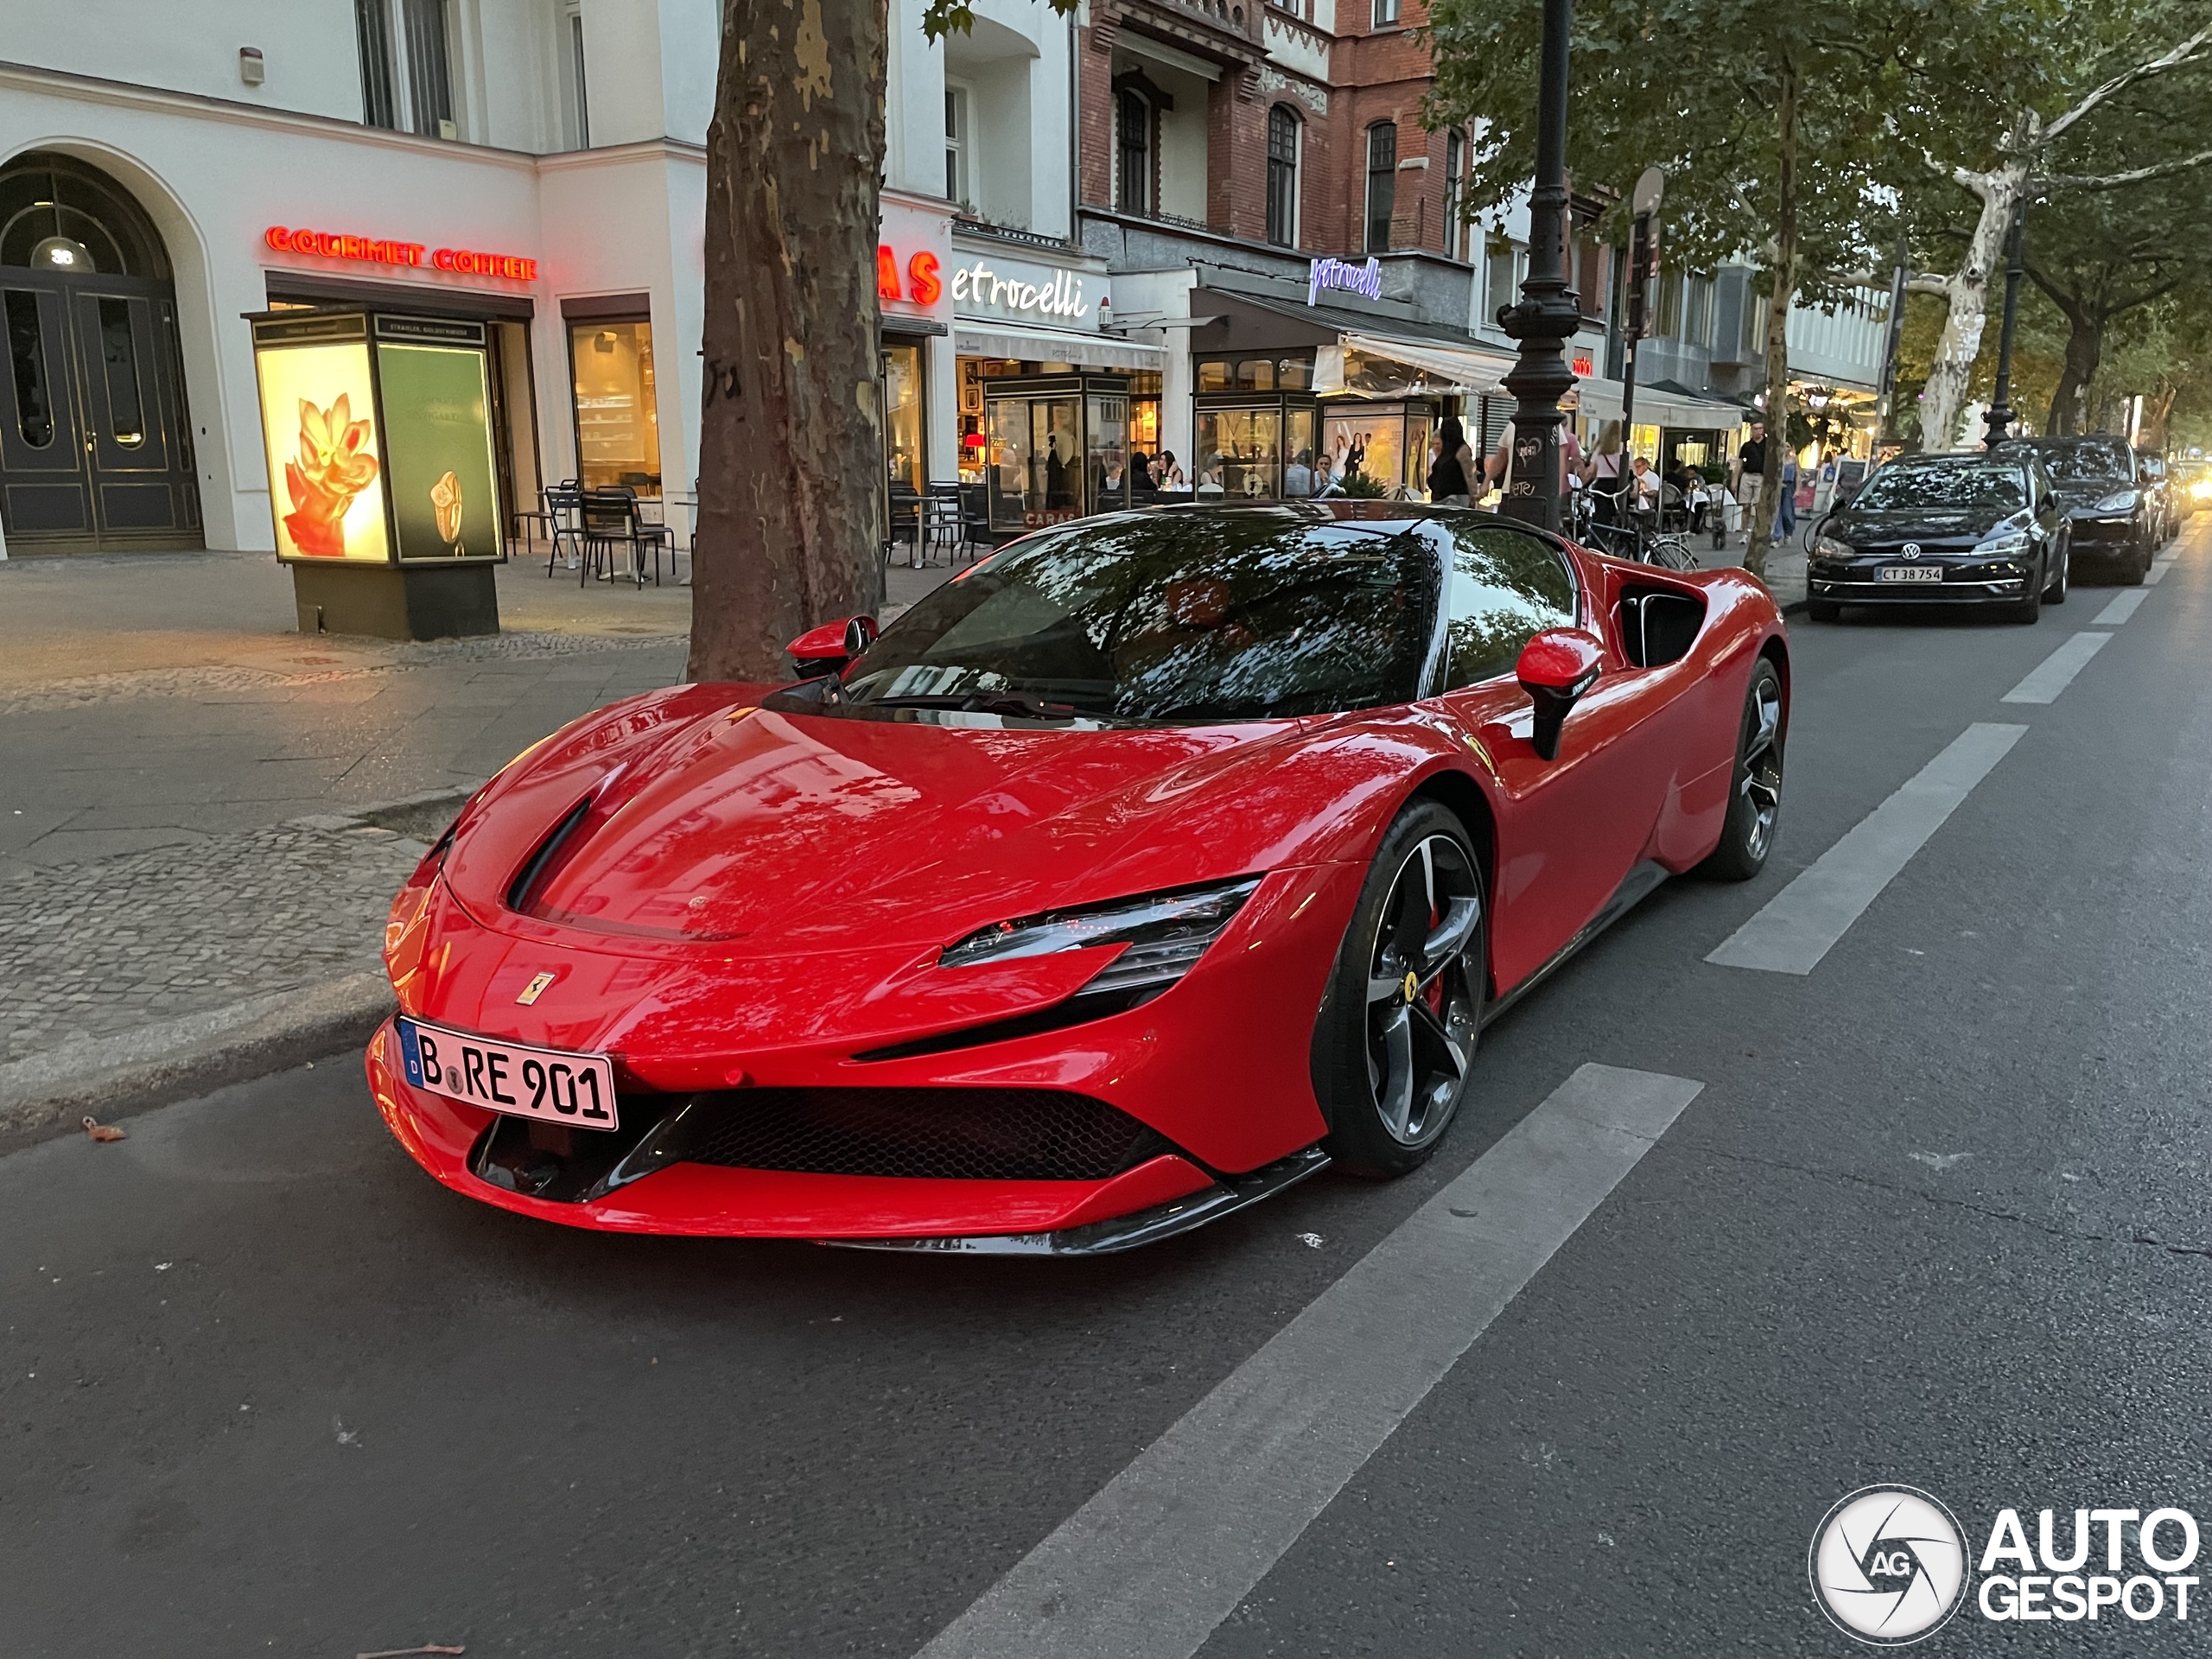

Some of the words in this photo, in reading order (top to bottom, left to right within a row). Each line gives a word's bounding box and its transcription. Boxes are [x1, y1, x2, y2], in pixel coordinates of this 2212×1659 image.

[265, 226, 426, 266] GOURMET
[433, 248, 538, 281] COFFEE
[878, 245, 942, 306] AS
[951, 261, 1089, 317] etrocelli
[1307, 257, 1382, 307] petrocelli
[1883, 569, 1899, 580] CT
[1901, 569, 1916, 580] 38
[1918, 569, 1941, 580] 754
[410, 1059, 419, 1075] D
[418, 1034, 442, 1085] B
[461, 1046, 517, 1105] RE
[522, 1058, 609, 1121] 901
